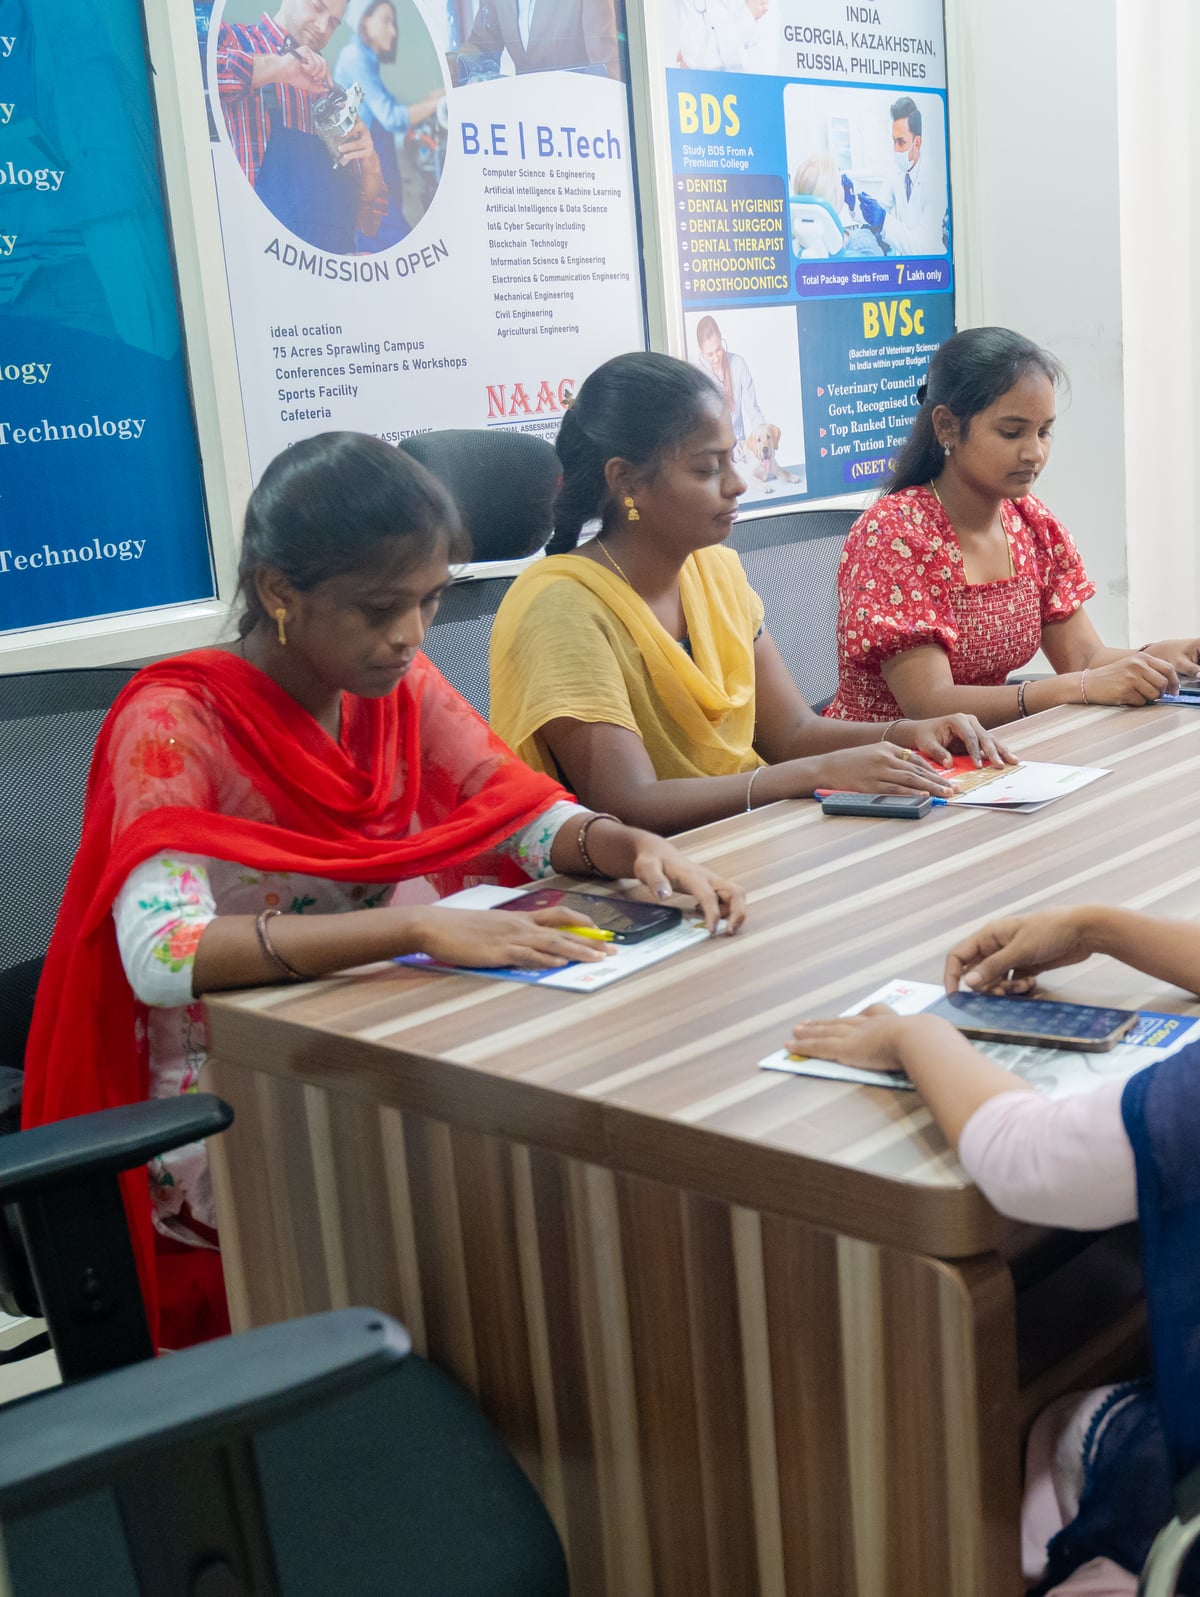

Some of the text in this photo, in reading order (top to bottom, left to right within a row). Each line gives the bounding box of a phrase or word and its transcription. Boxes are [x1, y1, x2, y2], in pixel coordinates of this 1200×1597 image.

[846, 5, 881, 25] INDIA
[784, 25, 936, 60] GEORGIA, KAZAKHSTAN,
[796, 52, 926, 79] RUSSIA, PHILIPPINES
[678, 92, 740, 136] BDS
[461, 122, 508, 156] B.E
[536, 126, 621, 159] B.Tech
[683, 144, 754, 157] Study BDS From A
[684, 157, 749, 171] Premium College
[482, 168, 595, 180] Computer Science & Engineering
[484, 186, 514, 195] Artificial
[558, 187, 563, 195] &
[565, 187, 591, 196] Machine
[593, 188, 621, 197] Learning
[686, 179, 727, 192] DENTIST
[486, 204, 516, 213] Artificial
[518, 204, 557, 214] Intelligence
[566, 205, 581, 213] Data
[583, 205, 608, 213] Science
[688, 199, 784, 213] DENTAL HYGIENIST
[503, 222, 524, 232] Cyber
[526, 222, 553, 233] Security
[556, 221, 586, 231] Including
[689, 219, 782, 233] DENTAL SURGEON
[489, 239, 568, 249] Blockchain Technology
[691, 238, 784, 253] DENTAL THERAPIST
[264, 238, 449, 283] ADMISSION OPEN
[490, 256, 605, 266] Information Science & Engineering
[692, 257, 776, 273] ORTHODONTICS
[492, 271, 630, 284] Electronics & Communication Engineering
[802, 264, 942, 286] Total Package Starts From 7 Lakh only
[693, 275, 789, 292] PROSTHODONTICS
[494, 290, 574, 301] Mechanical Engineering
[495, 309, 553, 319] Civil Engineering
[862, 299, 925, 339] BVSc
[270, 323, 342, 338] ideal ocation
[497, 324, 579, 338] Agricultural Engineering
[273, 340, 424, 359] 75 Acres Sprawling Campus
[879, 346, 885, 355] of
[886, 345, 915, 355] Veterinary
[276, 357, 467, 380] Conferences Seminars & Workshops
[857, 361, 871, 370] India
[873, 359, 890, 368] within
[892, 359, 905, 368] your
[906, 356, 926, 366] Budget
[278, 384, 358, 403] Sports Facility
[827, 382, 878, 397] Veterinary
[881, 376, 915, 390] Council
[856, 394, 907, 413] Recognised
[281, 406, 331, 422] Cafeteria
[0, 415, 146, 445] Technology
[830, 423, 848, 437] Top
[851, 419, 886, 434] Ranked
[831, 443, 851, 456] Low
[853, 438, 884, 452] Tution
[852, 458, 886, 479] (NEET
[0, 538, 146, 573] Technology
